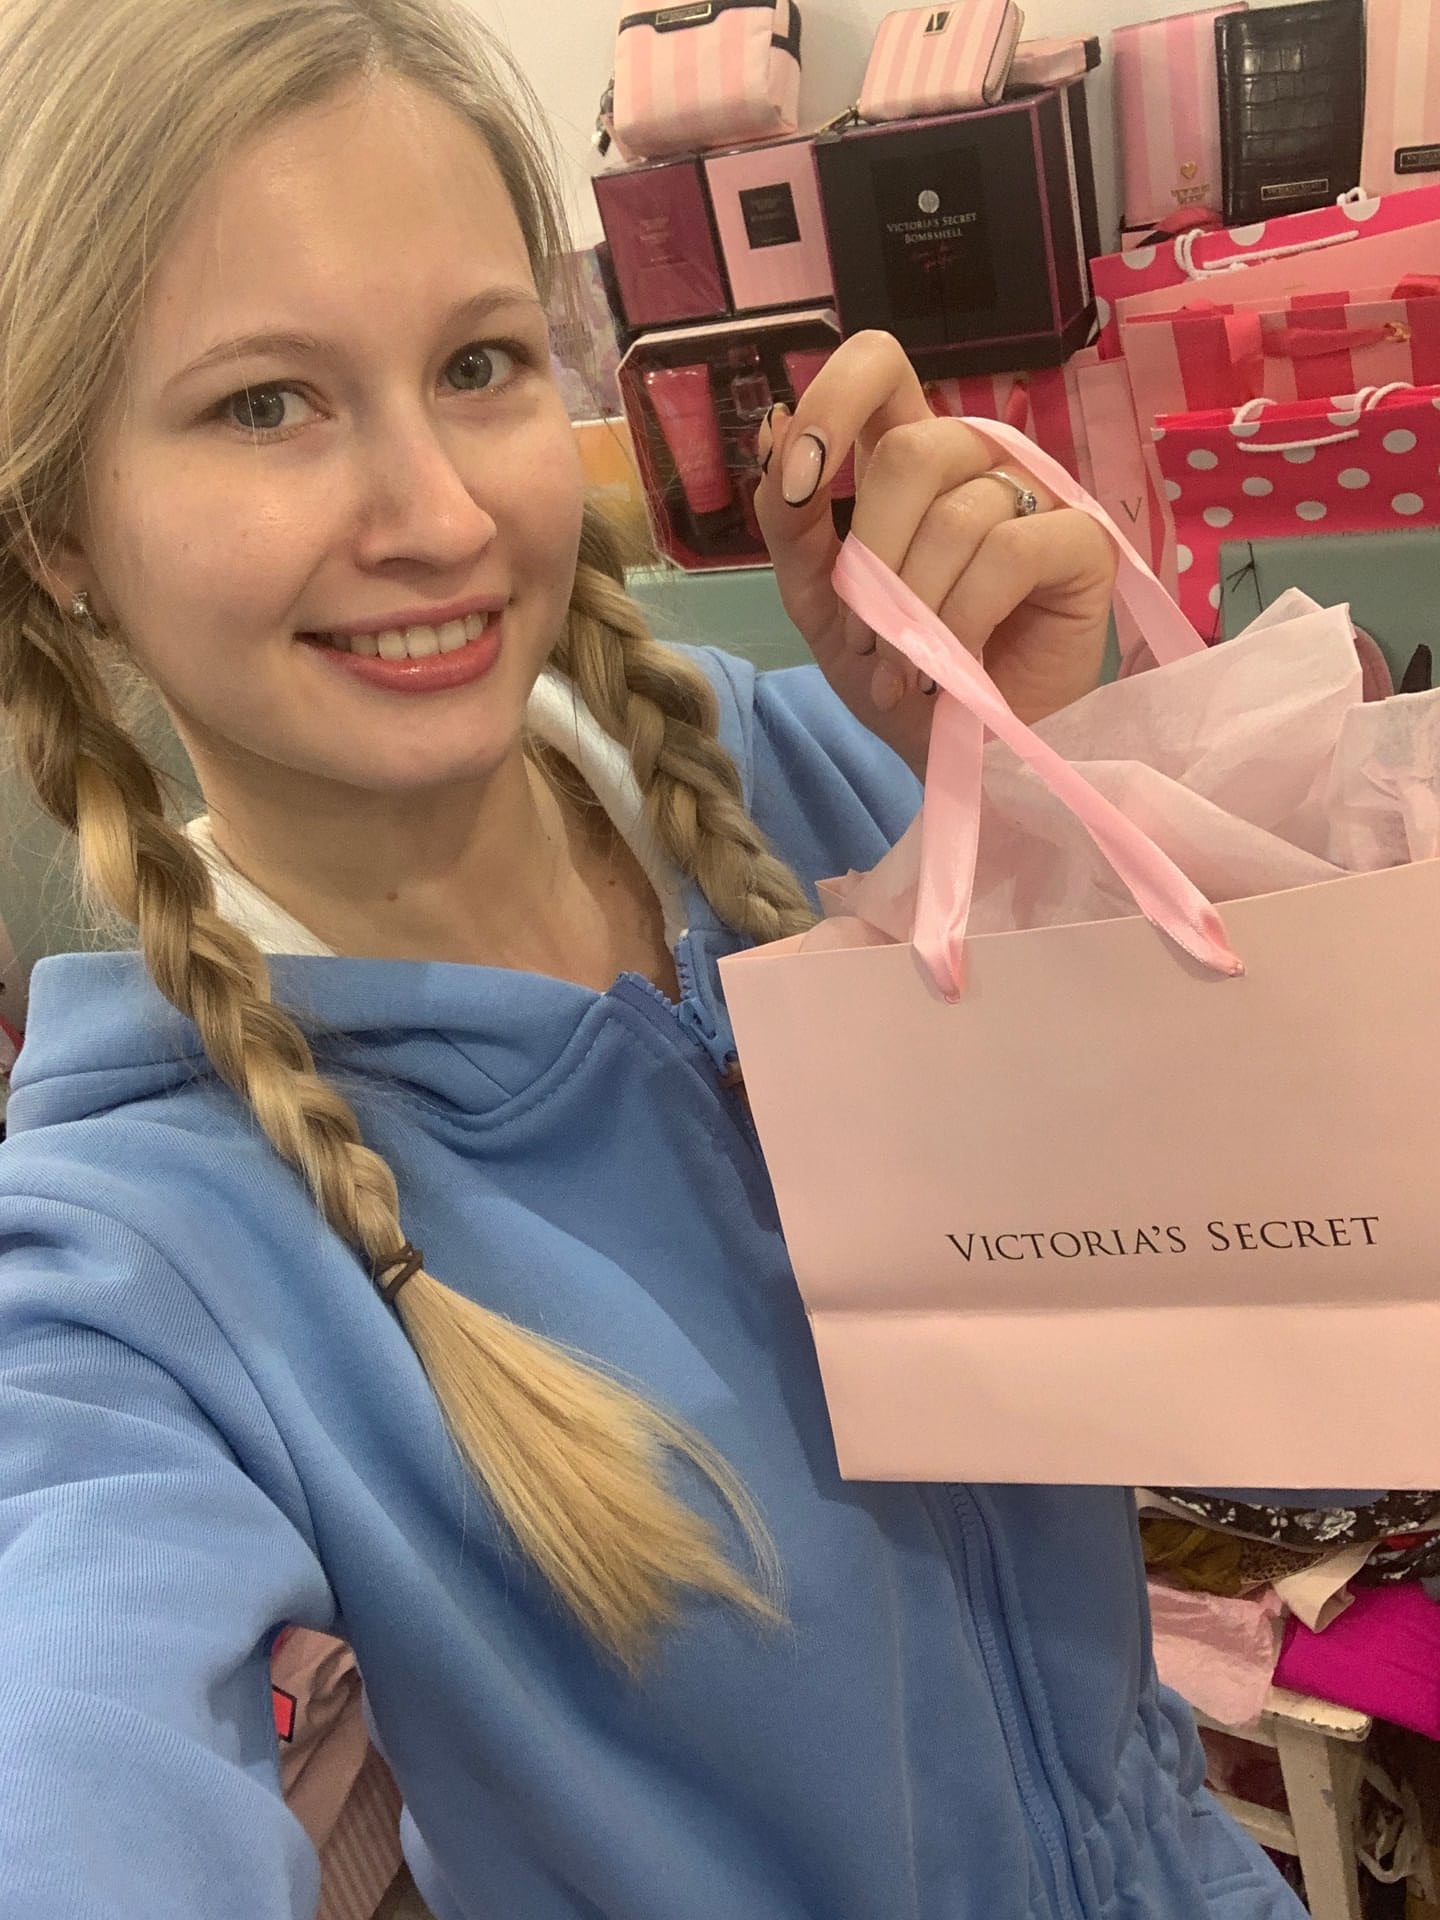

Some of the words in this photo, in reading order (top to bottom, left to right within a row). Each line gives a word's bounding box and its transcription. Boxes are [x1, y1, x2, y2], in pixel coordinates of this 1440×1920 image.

[943, 213, 977, 226] SECRET
[904, 229, 963, 245] BOMBSHELL
[1119, 496, 1143, 523] V
[946, 1225, 1188, 1263] VICTORIA'S
[1205, 1215, 1381, 1252] SECRET
